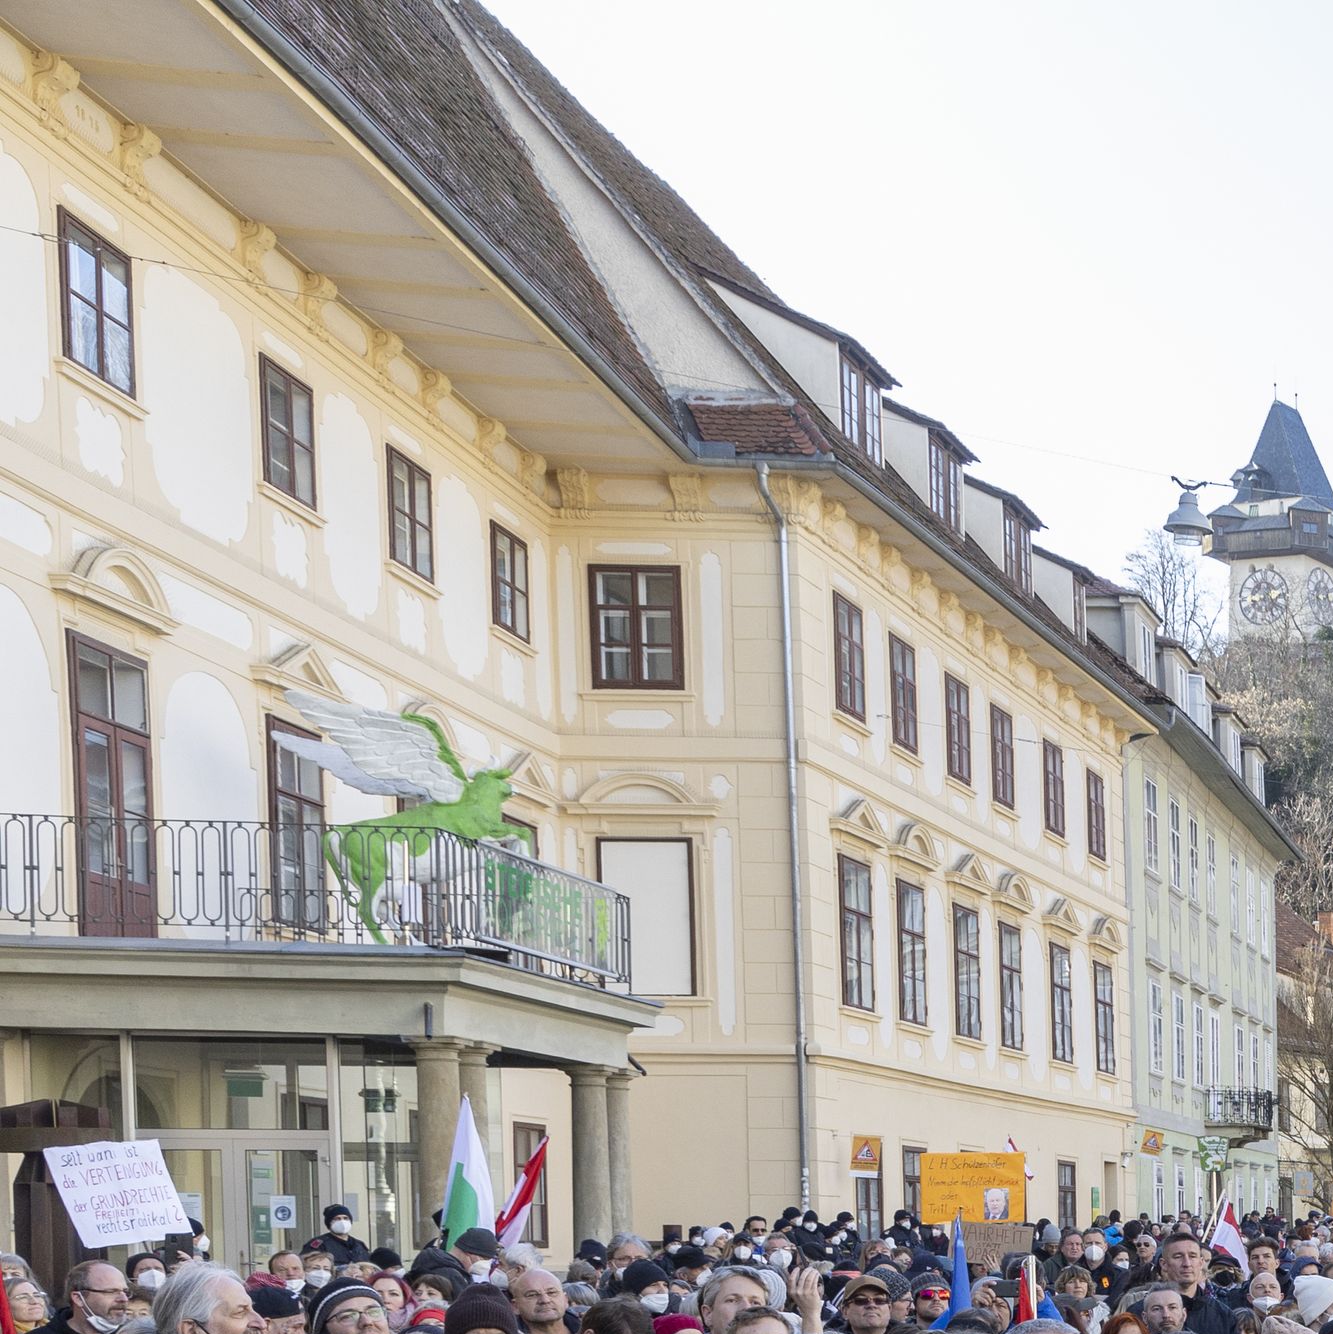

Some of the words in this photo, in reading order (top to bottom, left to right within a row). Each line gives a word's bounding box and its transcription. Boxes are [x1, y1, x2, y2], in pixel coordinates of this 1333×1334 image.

[124, 1146, 138, 1158] ist
[63, 1174, 78, 1189] die
[74, 1199, 87, 1213] der
[90, 1185, 173, 1210] GRUNDRECHTE
[964, 1225, 1028, 1244] AHRHEIT
